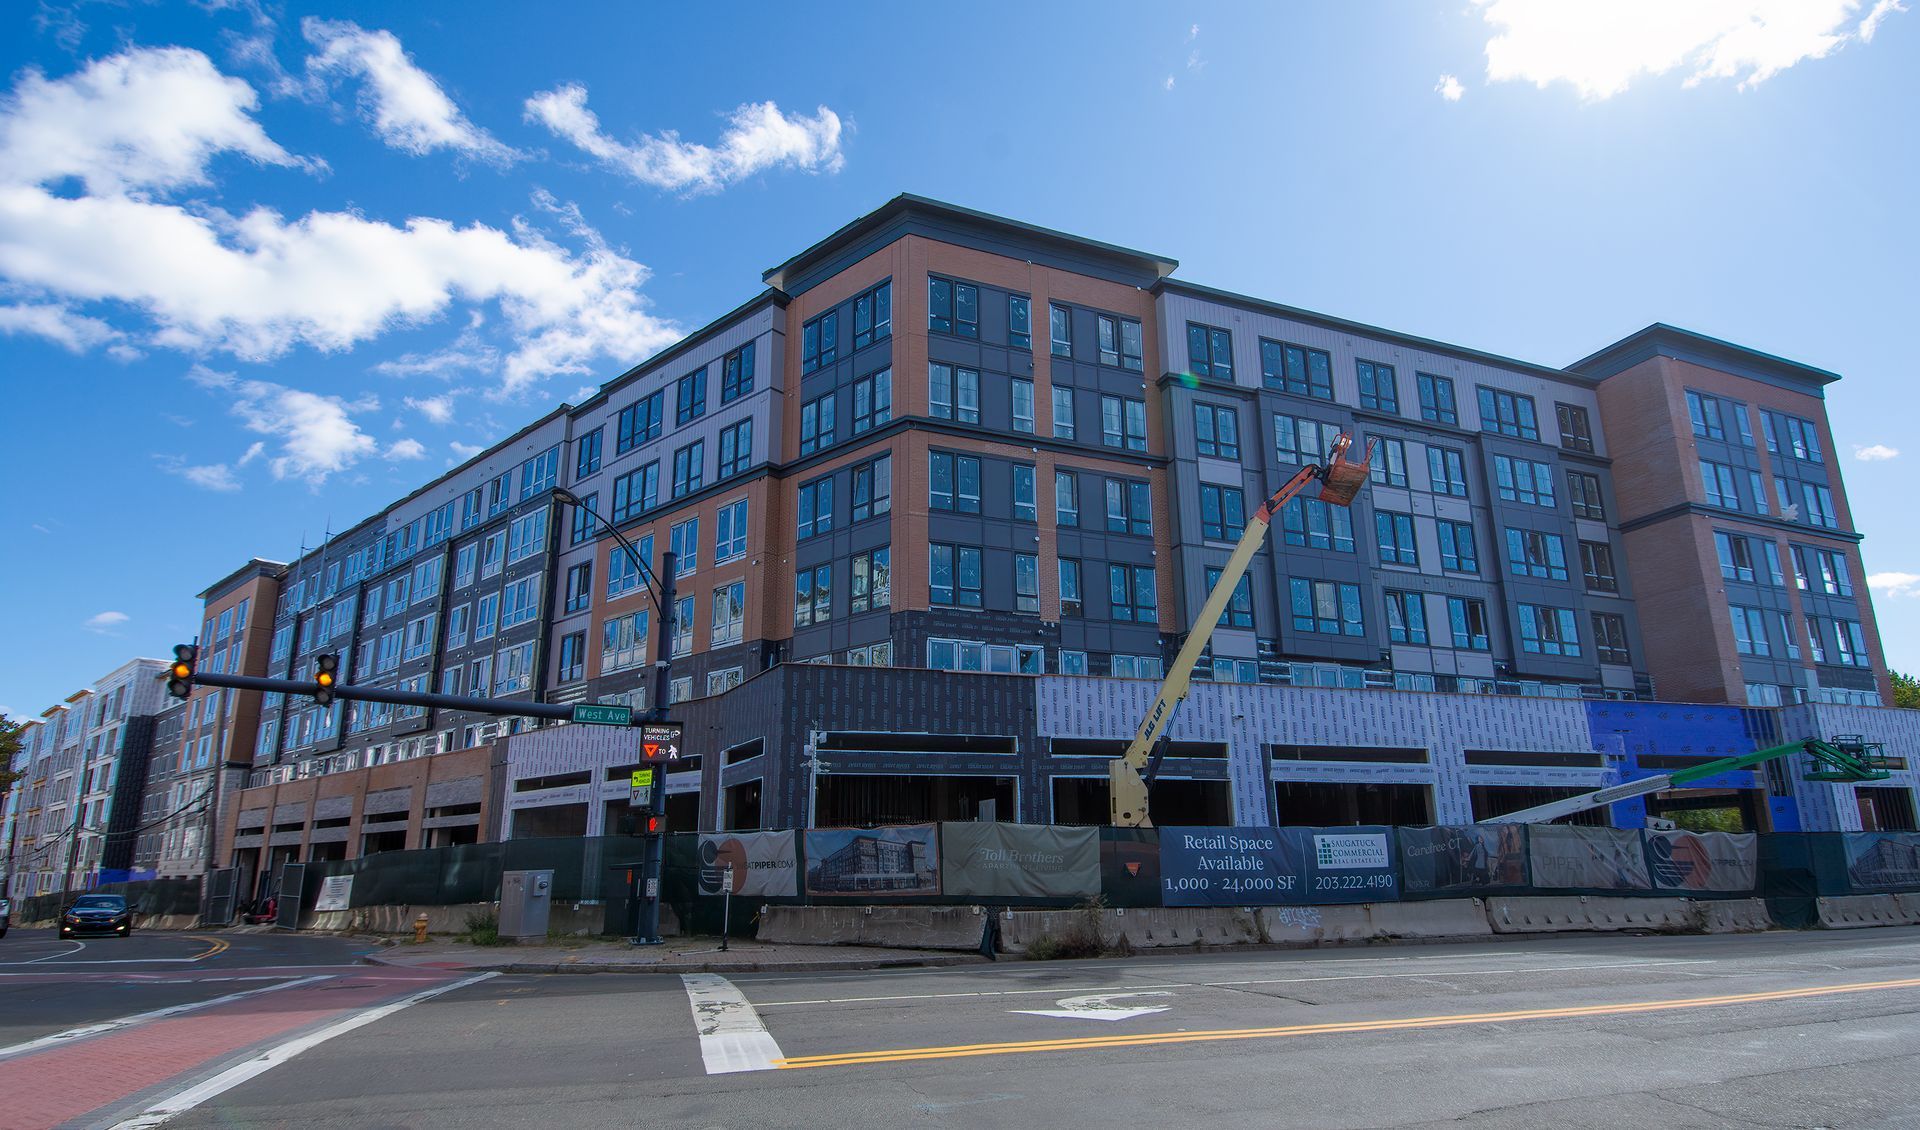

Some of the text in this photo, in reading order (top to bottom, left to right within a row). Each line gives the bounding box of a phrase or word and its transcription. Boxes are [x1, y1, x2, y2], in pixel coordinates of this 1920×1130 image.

[579, 708, 625, 720] West Ave
[1144, 699, 1166, 740] JLG LIFT
[1183, 834, 1274, 854] Retail Space
[1331, 839, 1376, 848] SAUGATUCK
[1407, 841, 1447, 857] Carefree
[980, 847, 1064, 864] Toll Brothers
[1333, 848, 1384, 857] COMMERCIAL
[1197, 855, 1264, 872] Available
[1542, 855, 1584, 870] PIPER
[1165, 876, 1209, 893] 1,000
[1222, 875, 1274, 893] 24,000
[1277, 874, 1297, 891] SF
[1315, 873, 1393, 890] 203.222.4190
